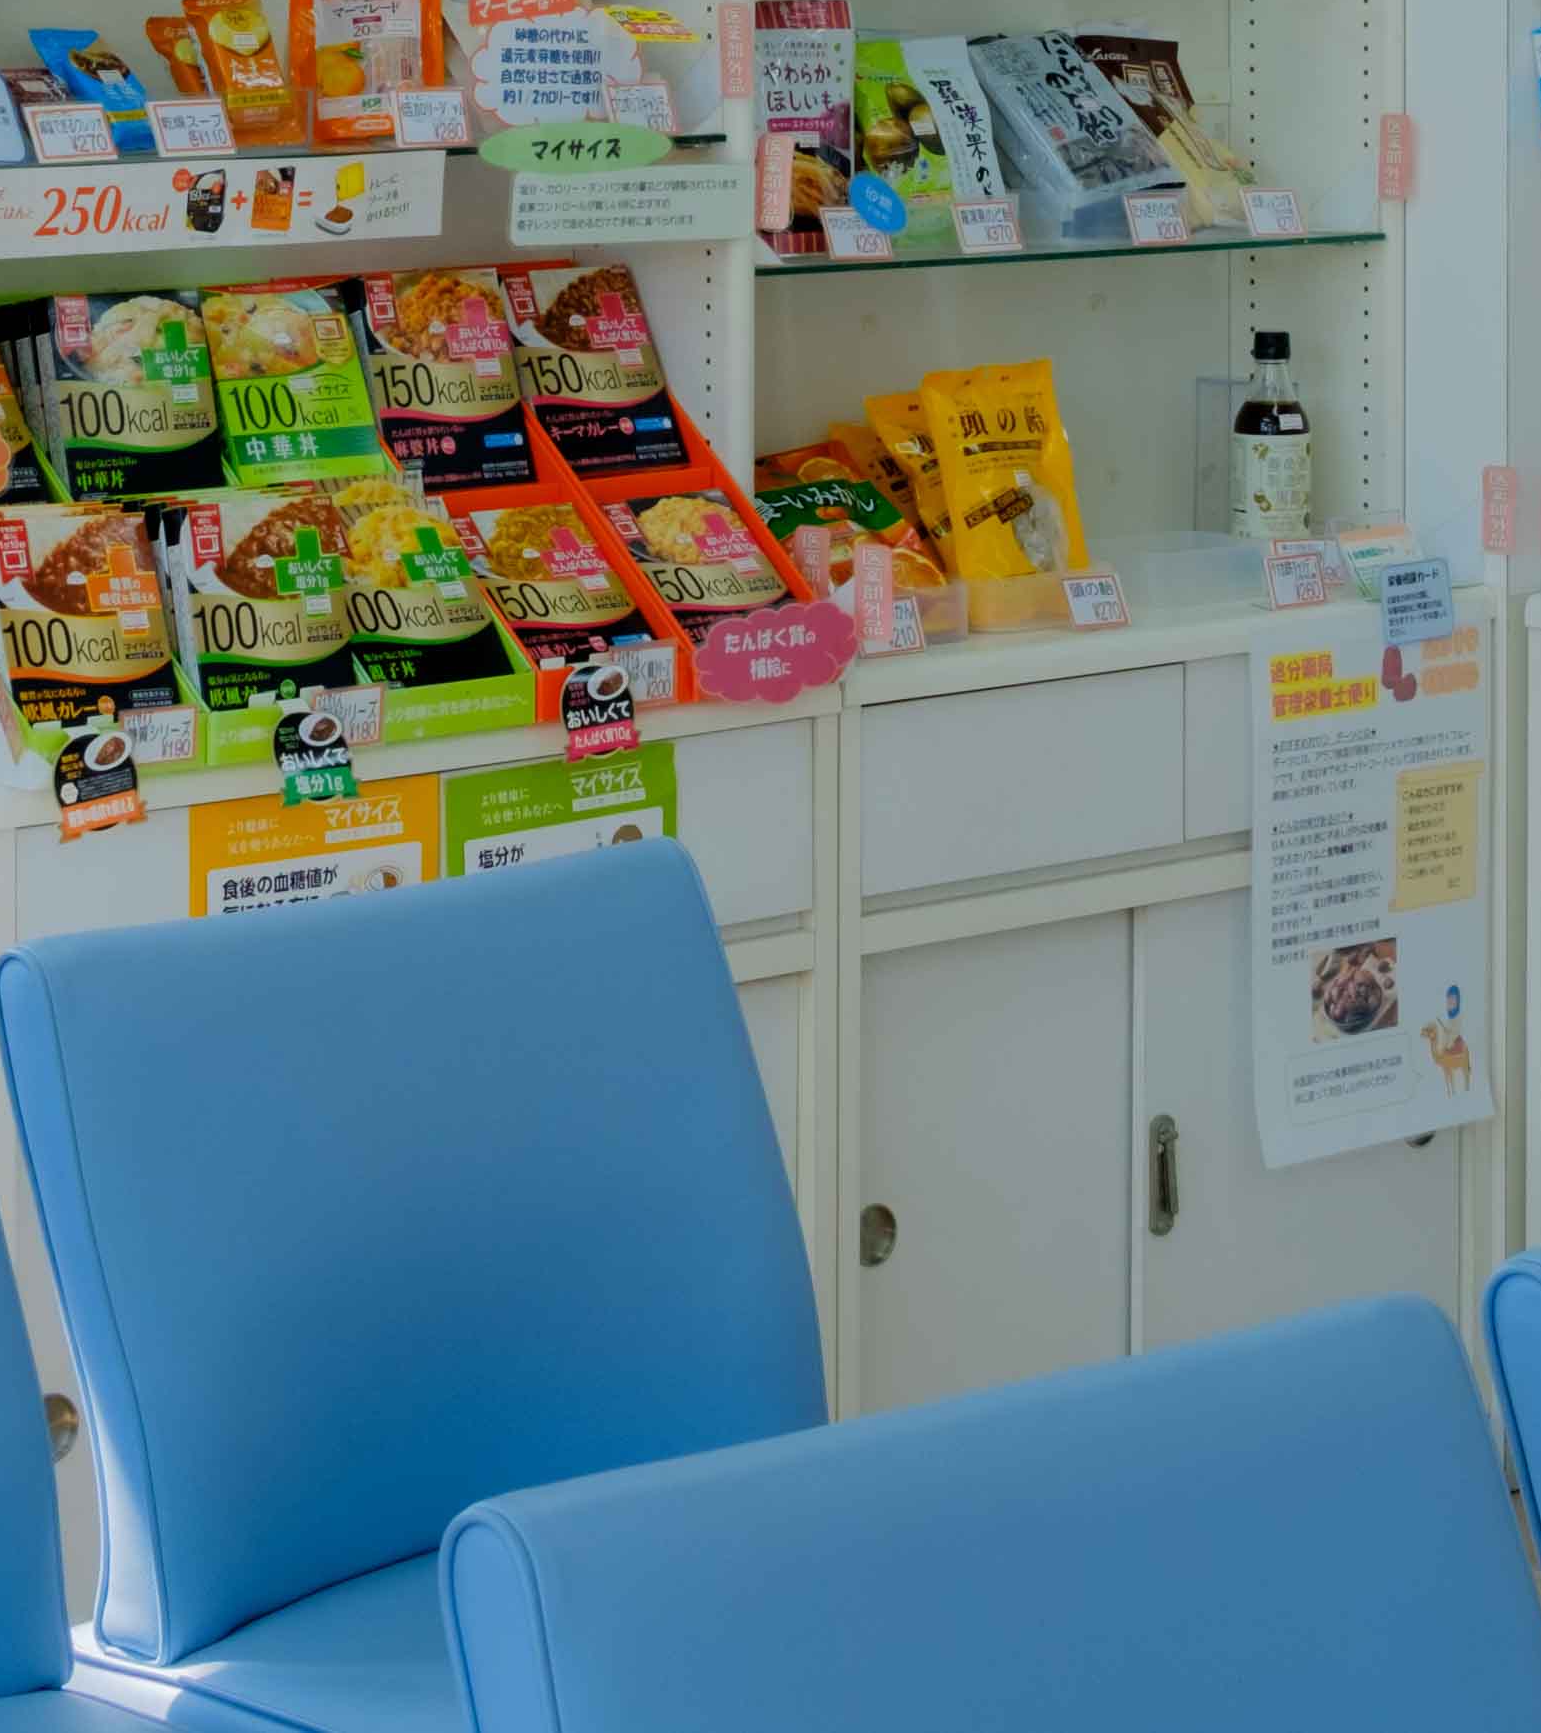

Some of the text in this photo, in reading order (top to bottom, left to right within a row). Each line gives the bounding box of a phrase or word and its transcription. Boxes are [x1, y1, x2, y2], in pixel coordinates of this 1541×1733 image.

[763, 62, 833, 85] やわらか
[766, 89, 835, 114] ほしいも
[532, 137, 622, 162] マイサイズ
[33, 185, 172, 237] 250 kcal
[373, 362, 477, 410] 150 kcal
[524, 354, 622, 398] 150 kcal
[63, 389, 170, 438] 100 kcal
[229, 379, 340, 431] 100 kcal
[245, 433, 320, 461] 中華丼
[549, 582, 593, 614] kcal
[702, 567, 743, 597] kcal
[196, 601, 303, 654] 100 kcal
[346, 589, 446, 634] 100 kcal
[3, 617, 120, 669] 100 kcal
[723, 621, 817, 654] たんぱく質の
[566, 698, 631, 729] おいしくて
[281, 747, 349, 771] おいしくて
[571, 764, 643, 797] マイサイズ
[324, 797, 402, 828] マイサイズ
[478, 844, 525, 869] 塩分が
[222, 864, 339, 901] 食後の血糖値が
